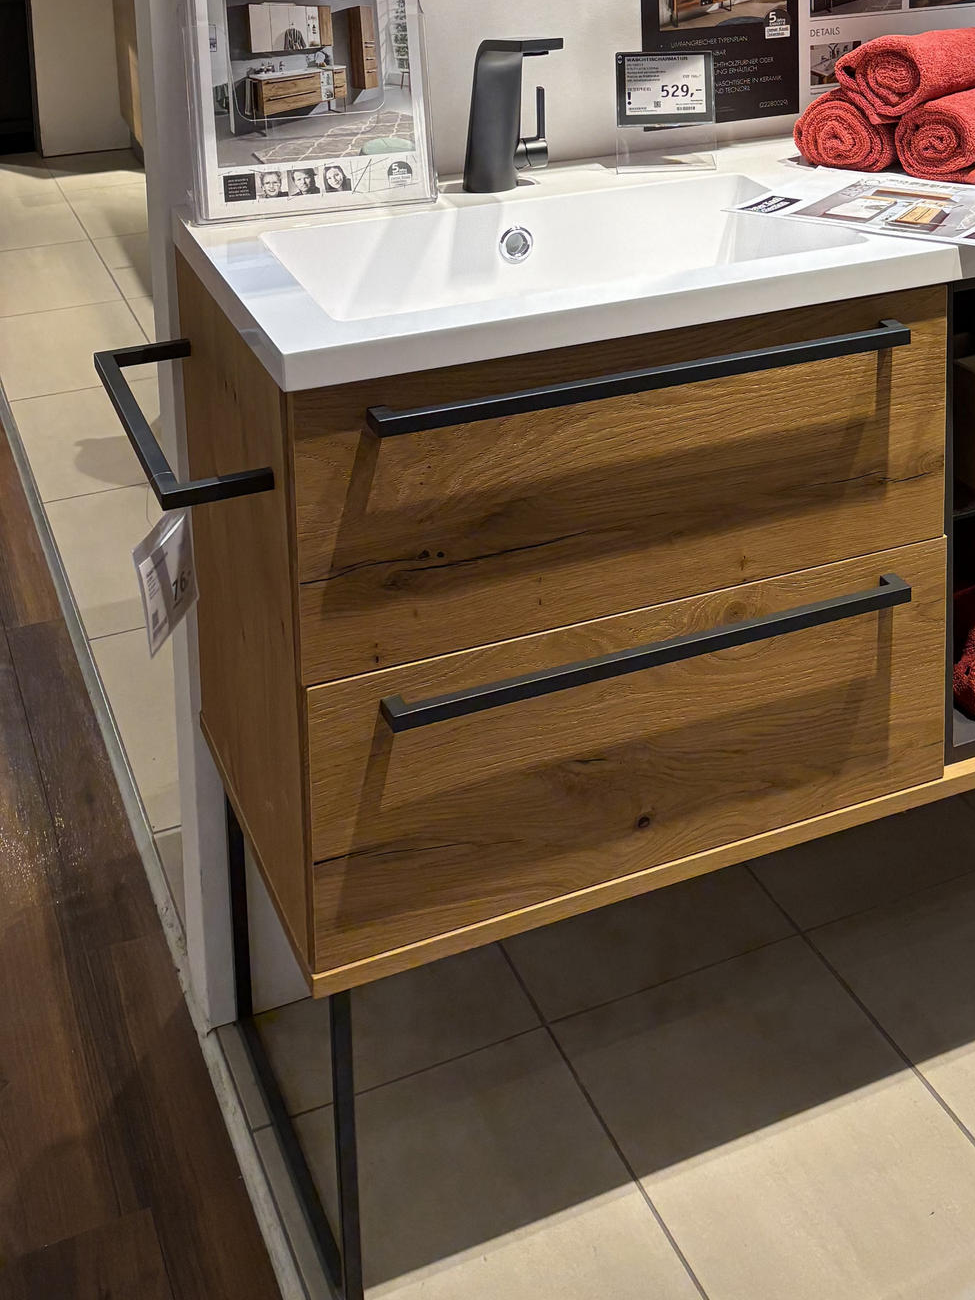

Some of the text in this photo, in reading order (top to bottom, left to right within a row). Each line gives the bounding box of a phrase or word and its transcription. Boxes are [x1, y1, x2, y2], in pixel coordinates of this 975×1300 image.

[768, 11, 777, 23] 5
[809, 26, 841, 38] DETAILS
[660, 84, 703, 98] 529,-
